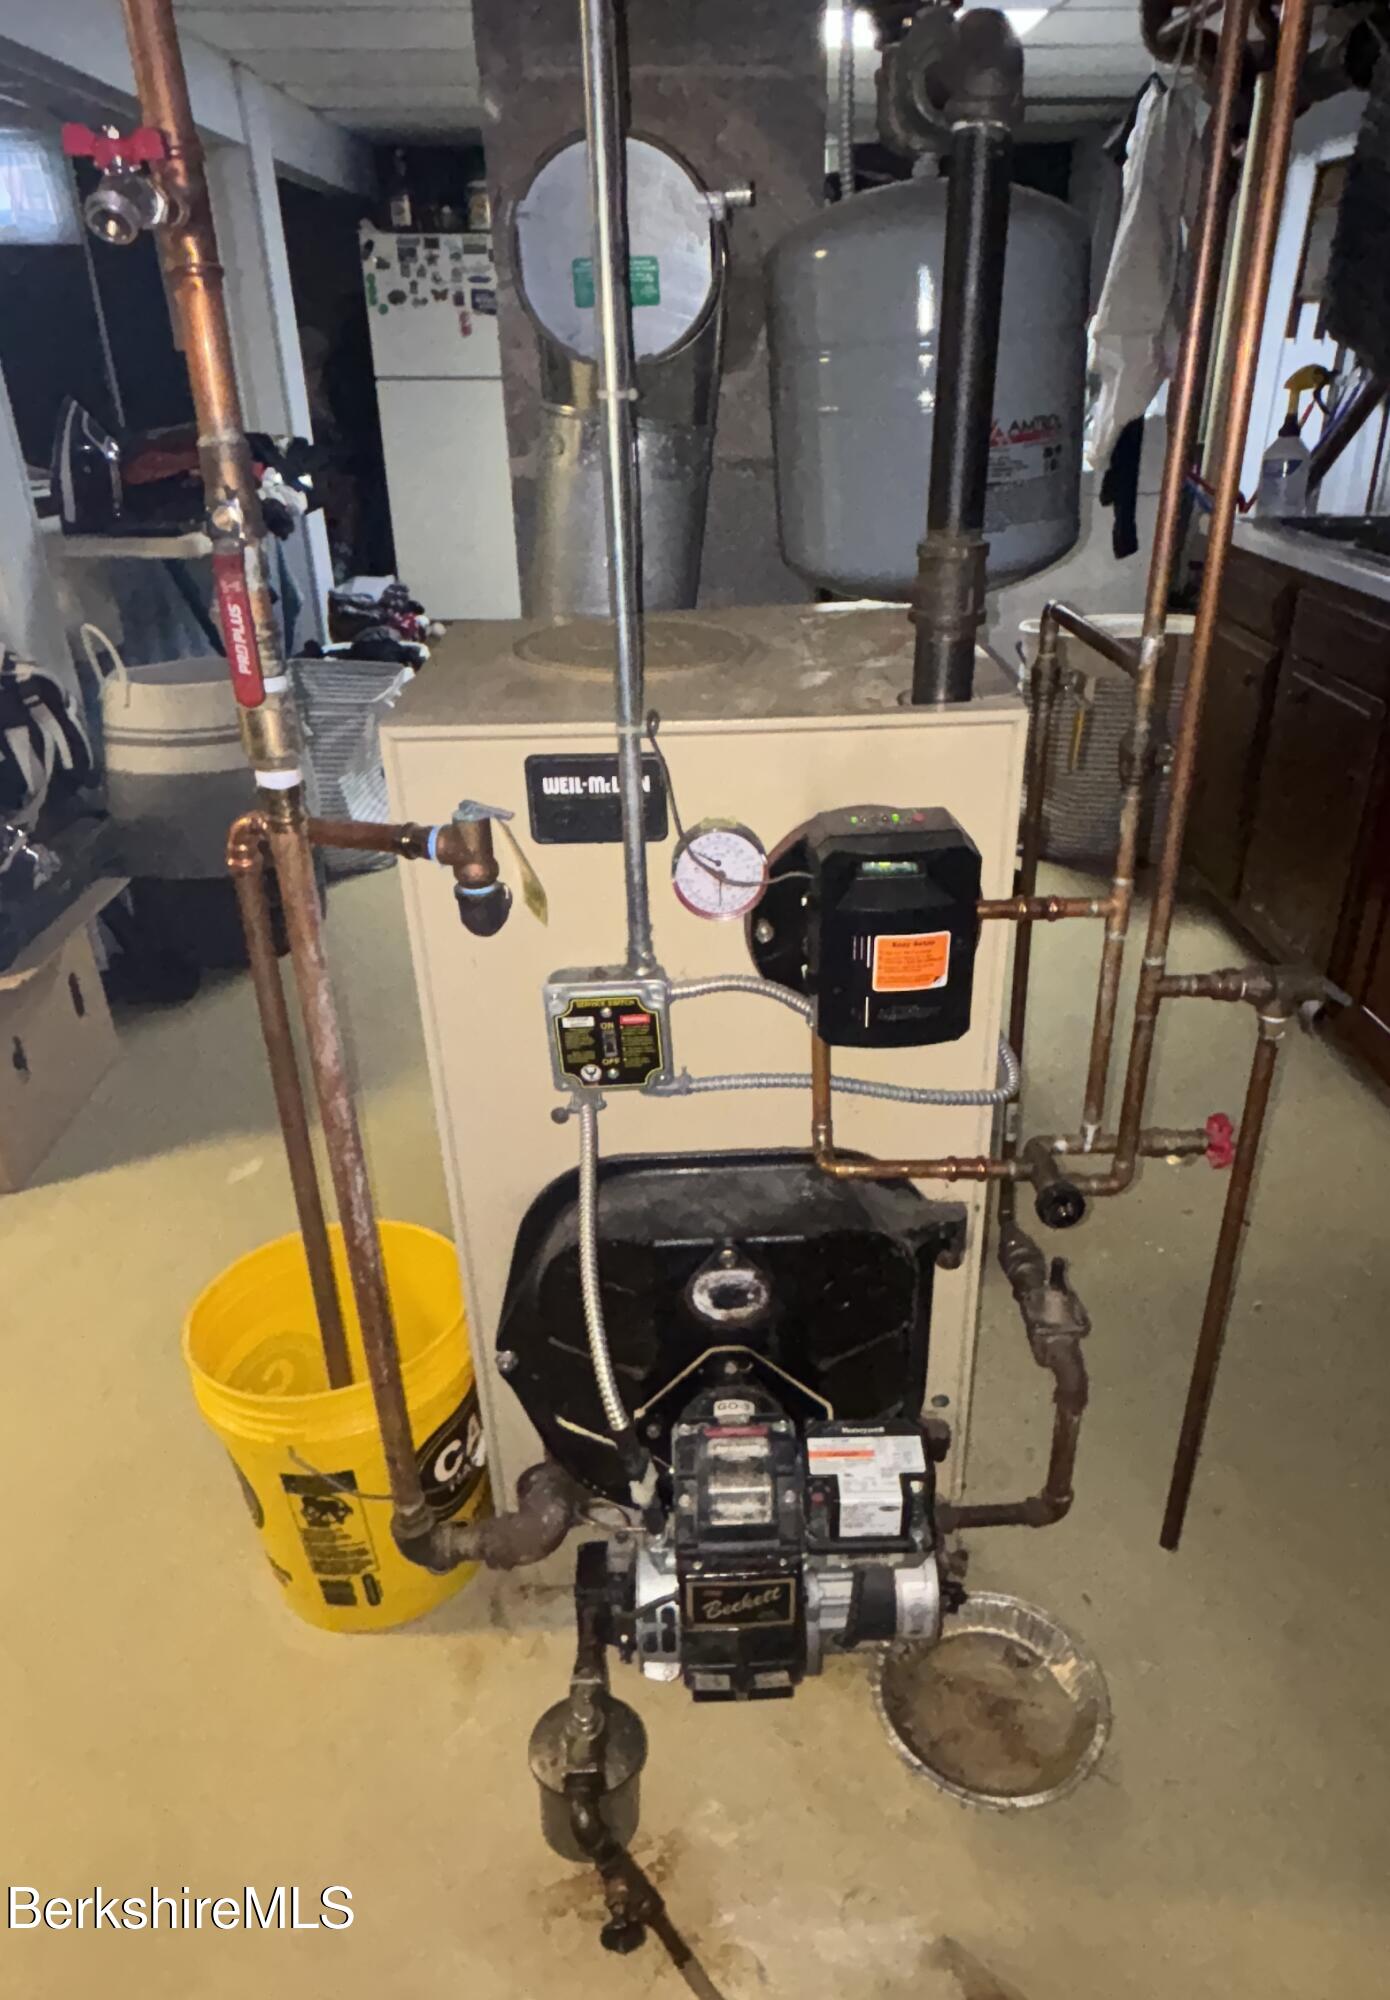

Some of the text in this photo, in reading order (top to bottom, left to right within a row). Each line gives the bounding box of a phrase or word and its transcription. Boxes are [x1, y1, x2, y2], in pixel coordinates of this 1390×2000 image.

[601, 1022, 615, 1030] ON
[602, 1058, 620, 1066] OFF
[702, 1586, 782, 1620] Beckett
